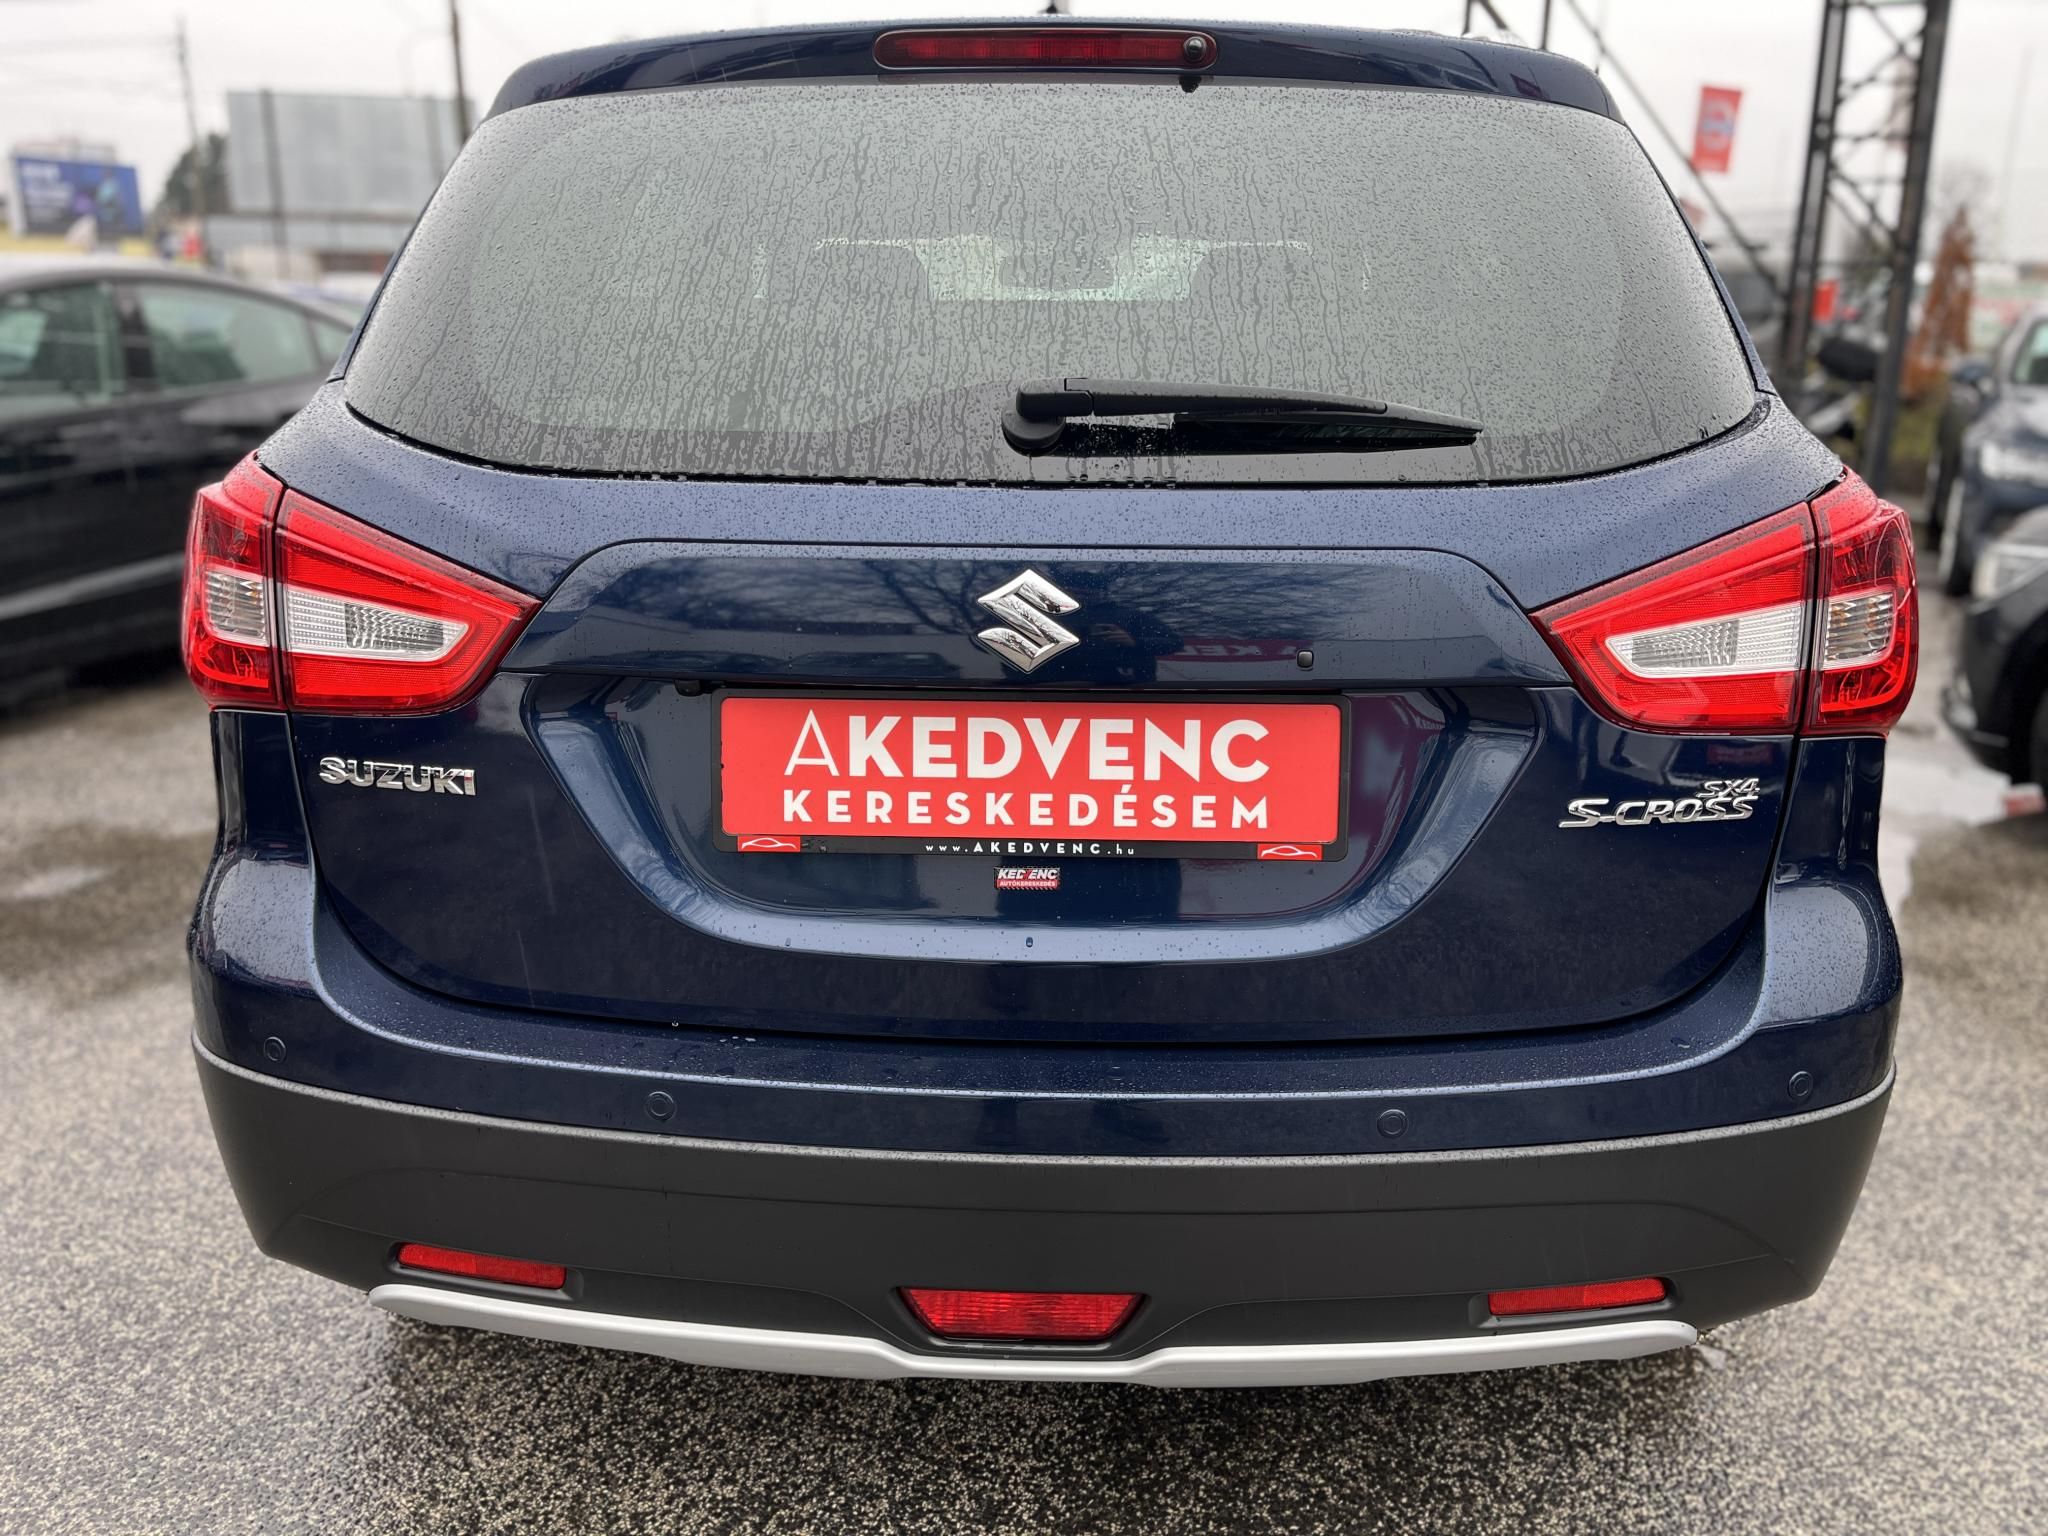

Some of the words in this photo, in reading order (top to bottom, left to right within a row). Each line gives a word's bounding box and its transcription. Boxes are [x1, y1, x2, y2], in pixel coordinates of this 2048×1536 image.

[319, 756, 476, 796] SUZUKI
[1696, 777, 1761, 799] SX4
[784, 784, 1269, 830] KERESKEDÉSEM
[1558, 796, 1759, 828] S-CROSS
[925, 841, 1135, 856] www.AKEDVENC.hu
